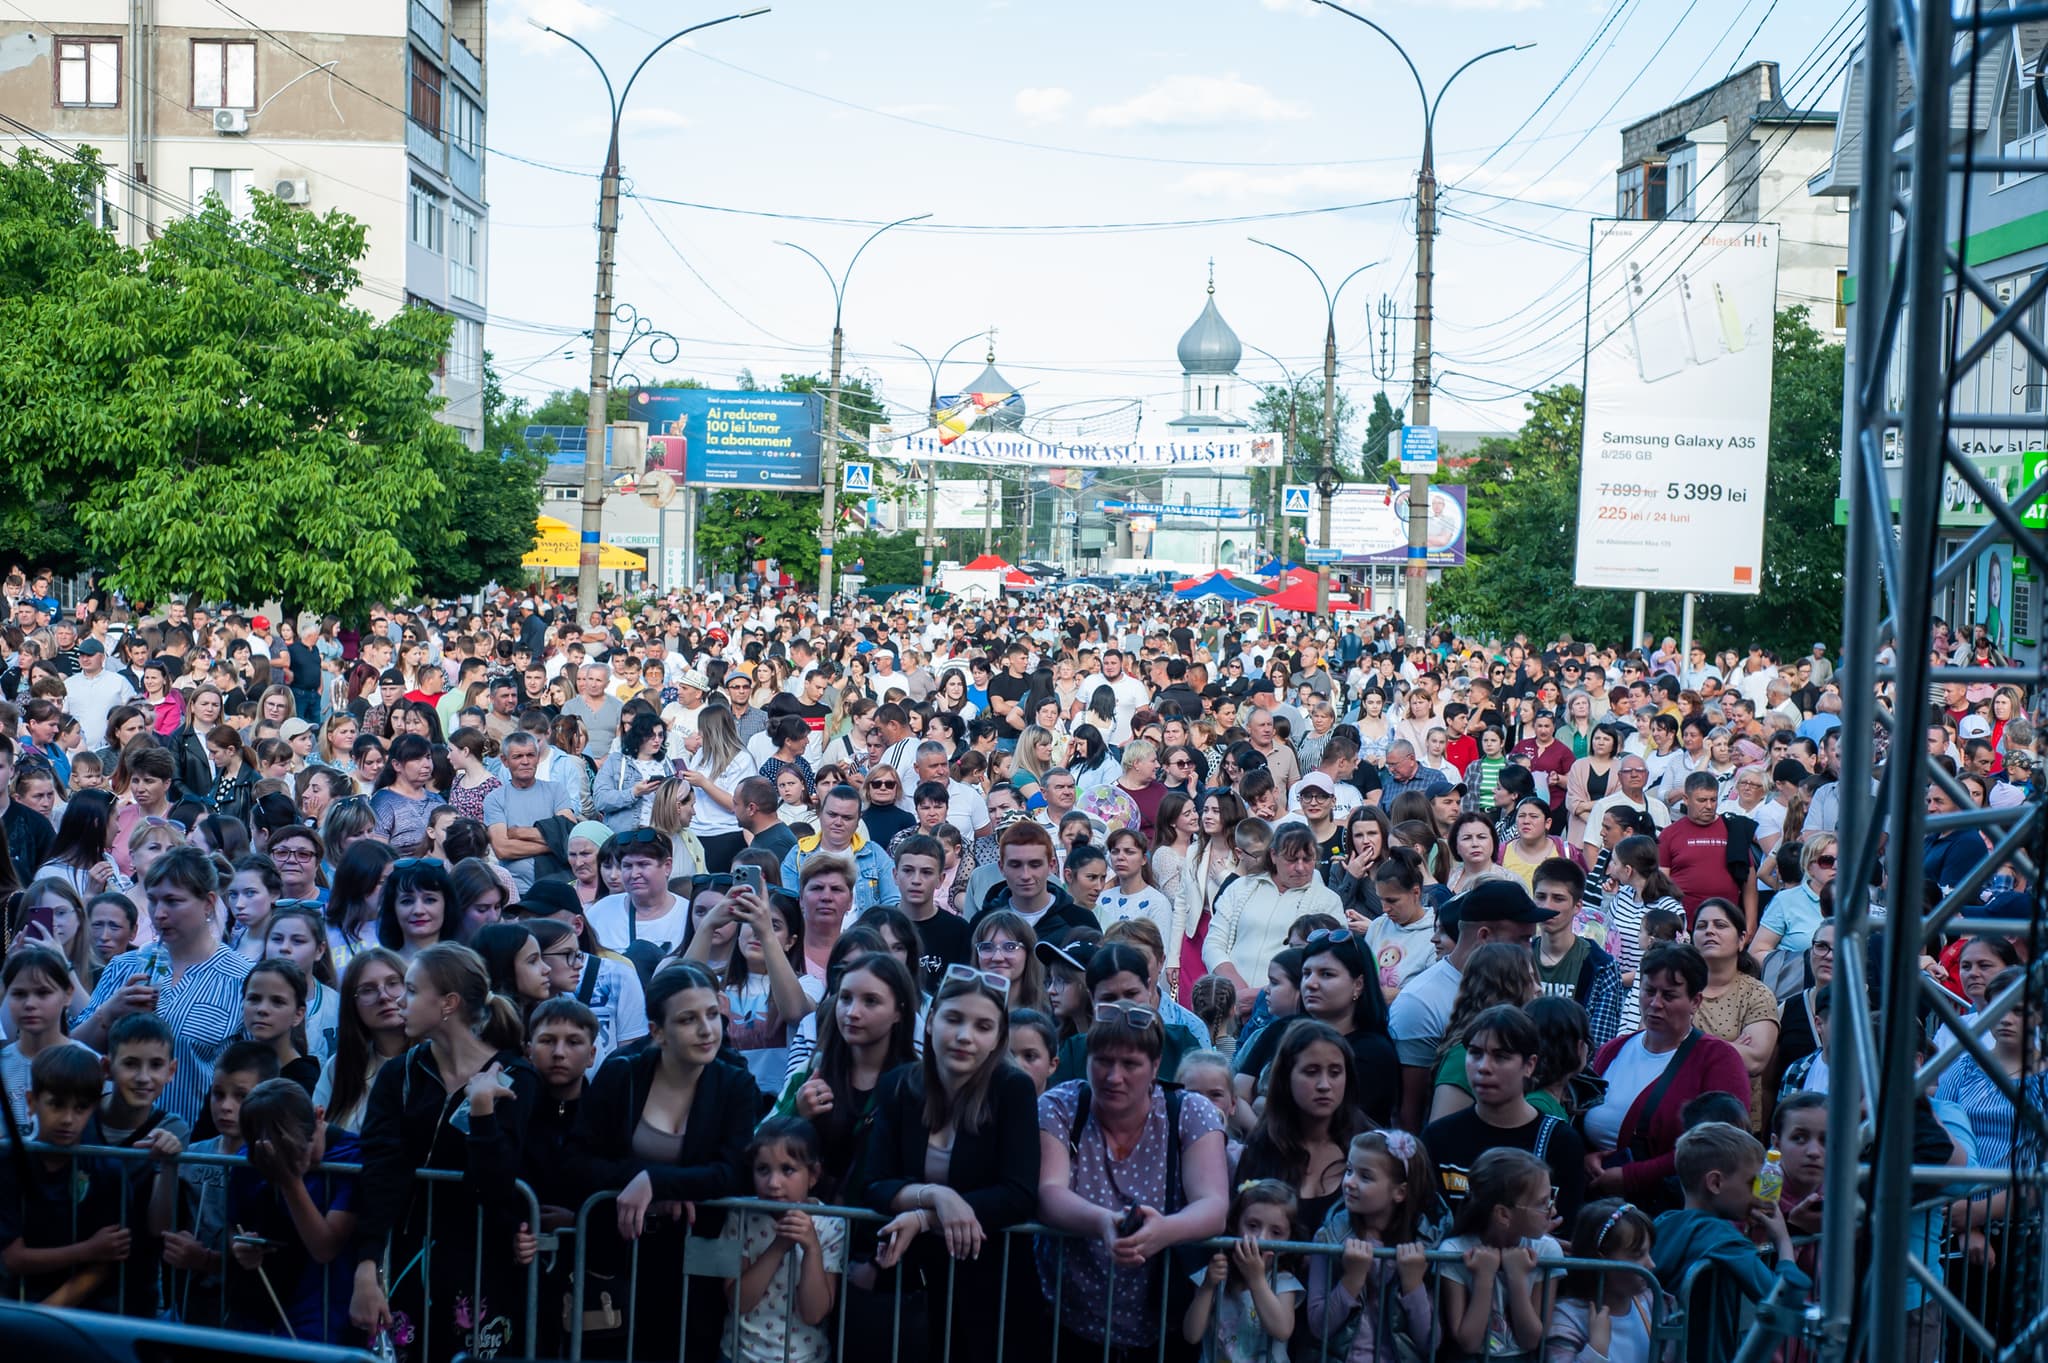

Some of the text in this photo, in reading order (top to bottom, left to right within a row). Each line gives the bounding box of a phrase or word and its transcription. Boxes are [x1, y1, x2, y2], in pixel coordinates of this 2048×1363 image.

[1700, 231, 1768, 248] Oferta H!t
[707, 407, 777, 421] Ai reducere
[706, 420, 781, 434] 100 lei lunar
[706, 432, 792, 447] la abonament
[1602, 431, 1756, 450] Samsung Galaxy A35
[1038, 443, 1064, 459] DE
[1069, 442, 1150, 463] ORAȘUL
[1155, 441, 1241, 463] FĂLEȘTI!
[1601, 449, 1653, 461] 8/256 GB
[1728, 488, 1747, 503] lei
[1598, 506, 1627, 520] 225
[1630, 512, 1643, 521] lei
[1654, 512, 1666, 522] 24
[1670, 512, 1690, 523] luni
[2024, 503, 2048, 519] AT
[1367, 573, 1406, 583] COFFE
